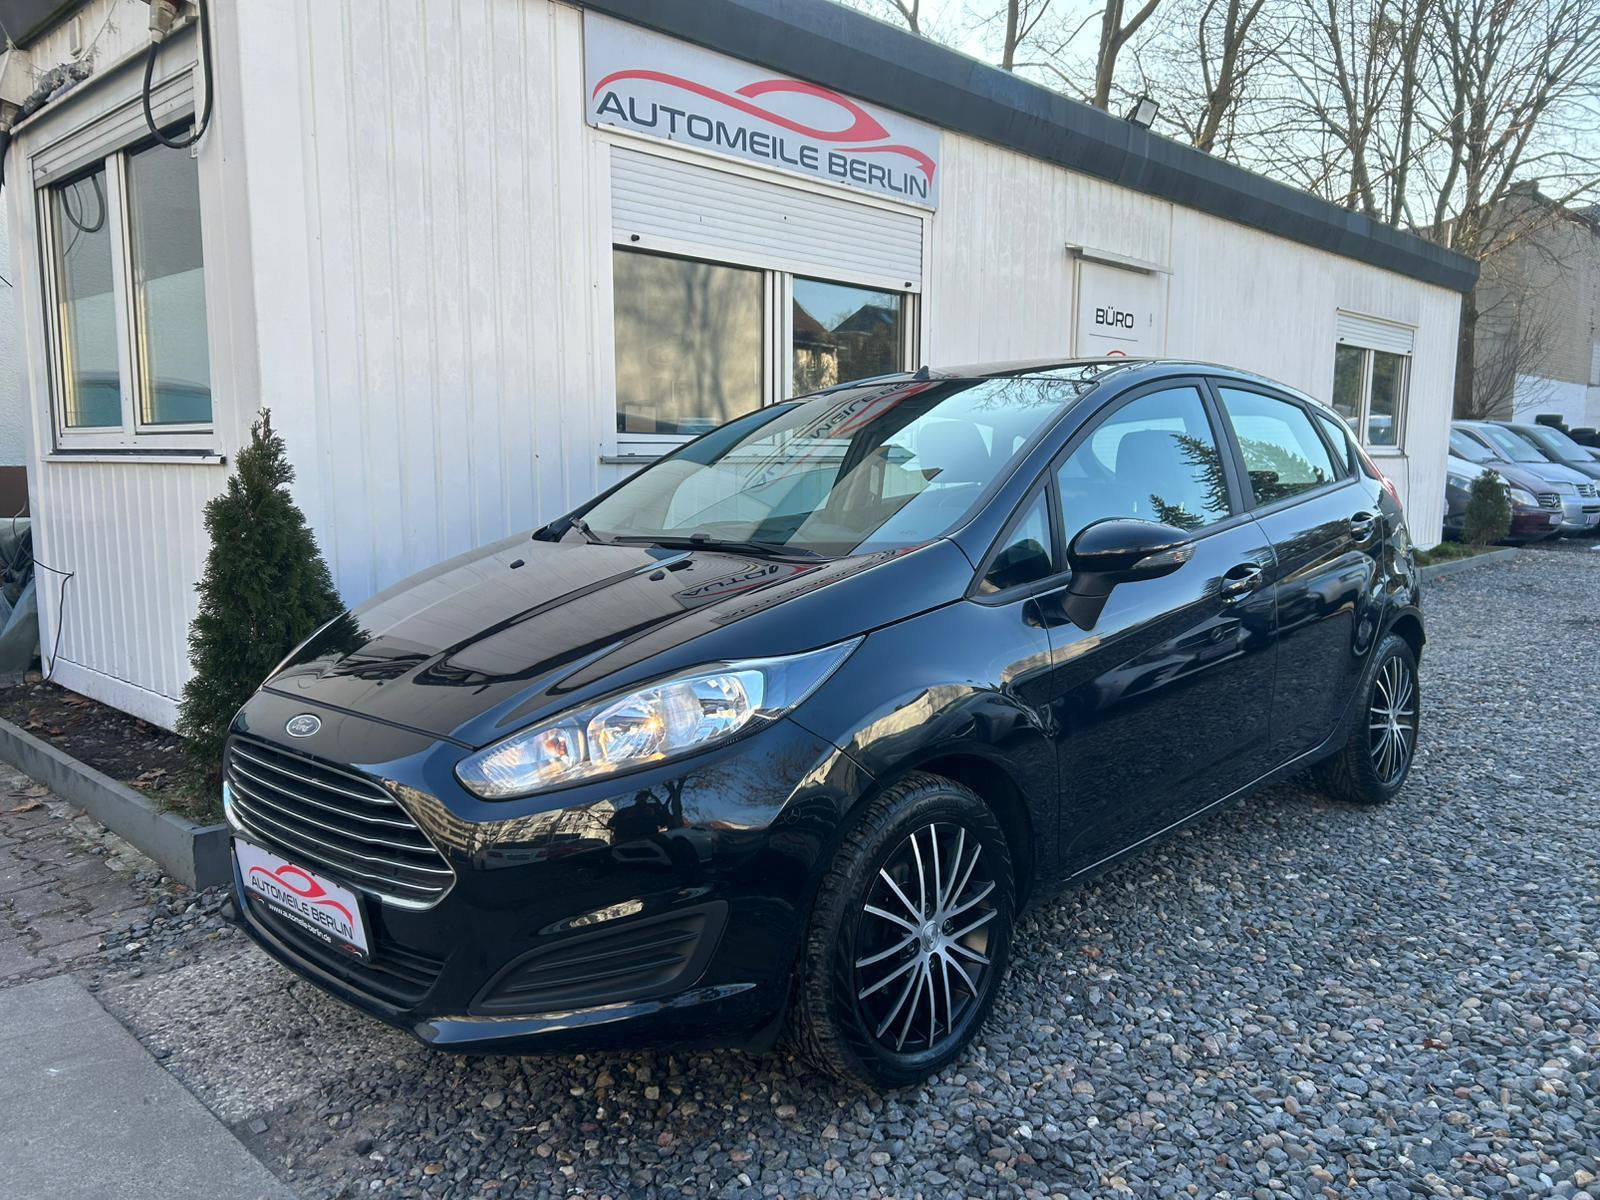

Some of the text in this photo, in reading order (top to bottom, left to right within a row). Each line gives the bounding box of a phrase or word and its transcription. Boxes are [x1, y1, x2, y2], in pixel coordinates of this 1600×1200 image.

[596, 91, 928, 199] AUTOMEILE BERLIN
[1095, 305, 1135, 329] BÜRO
[251, 875, 354, 940] AUTOMEILE BERLIN
